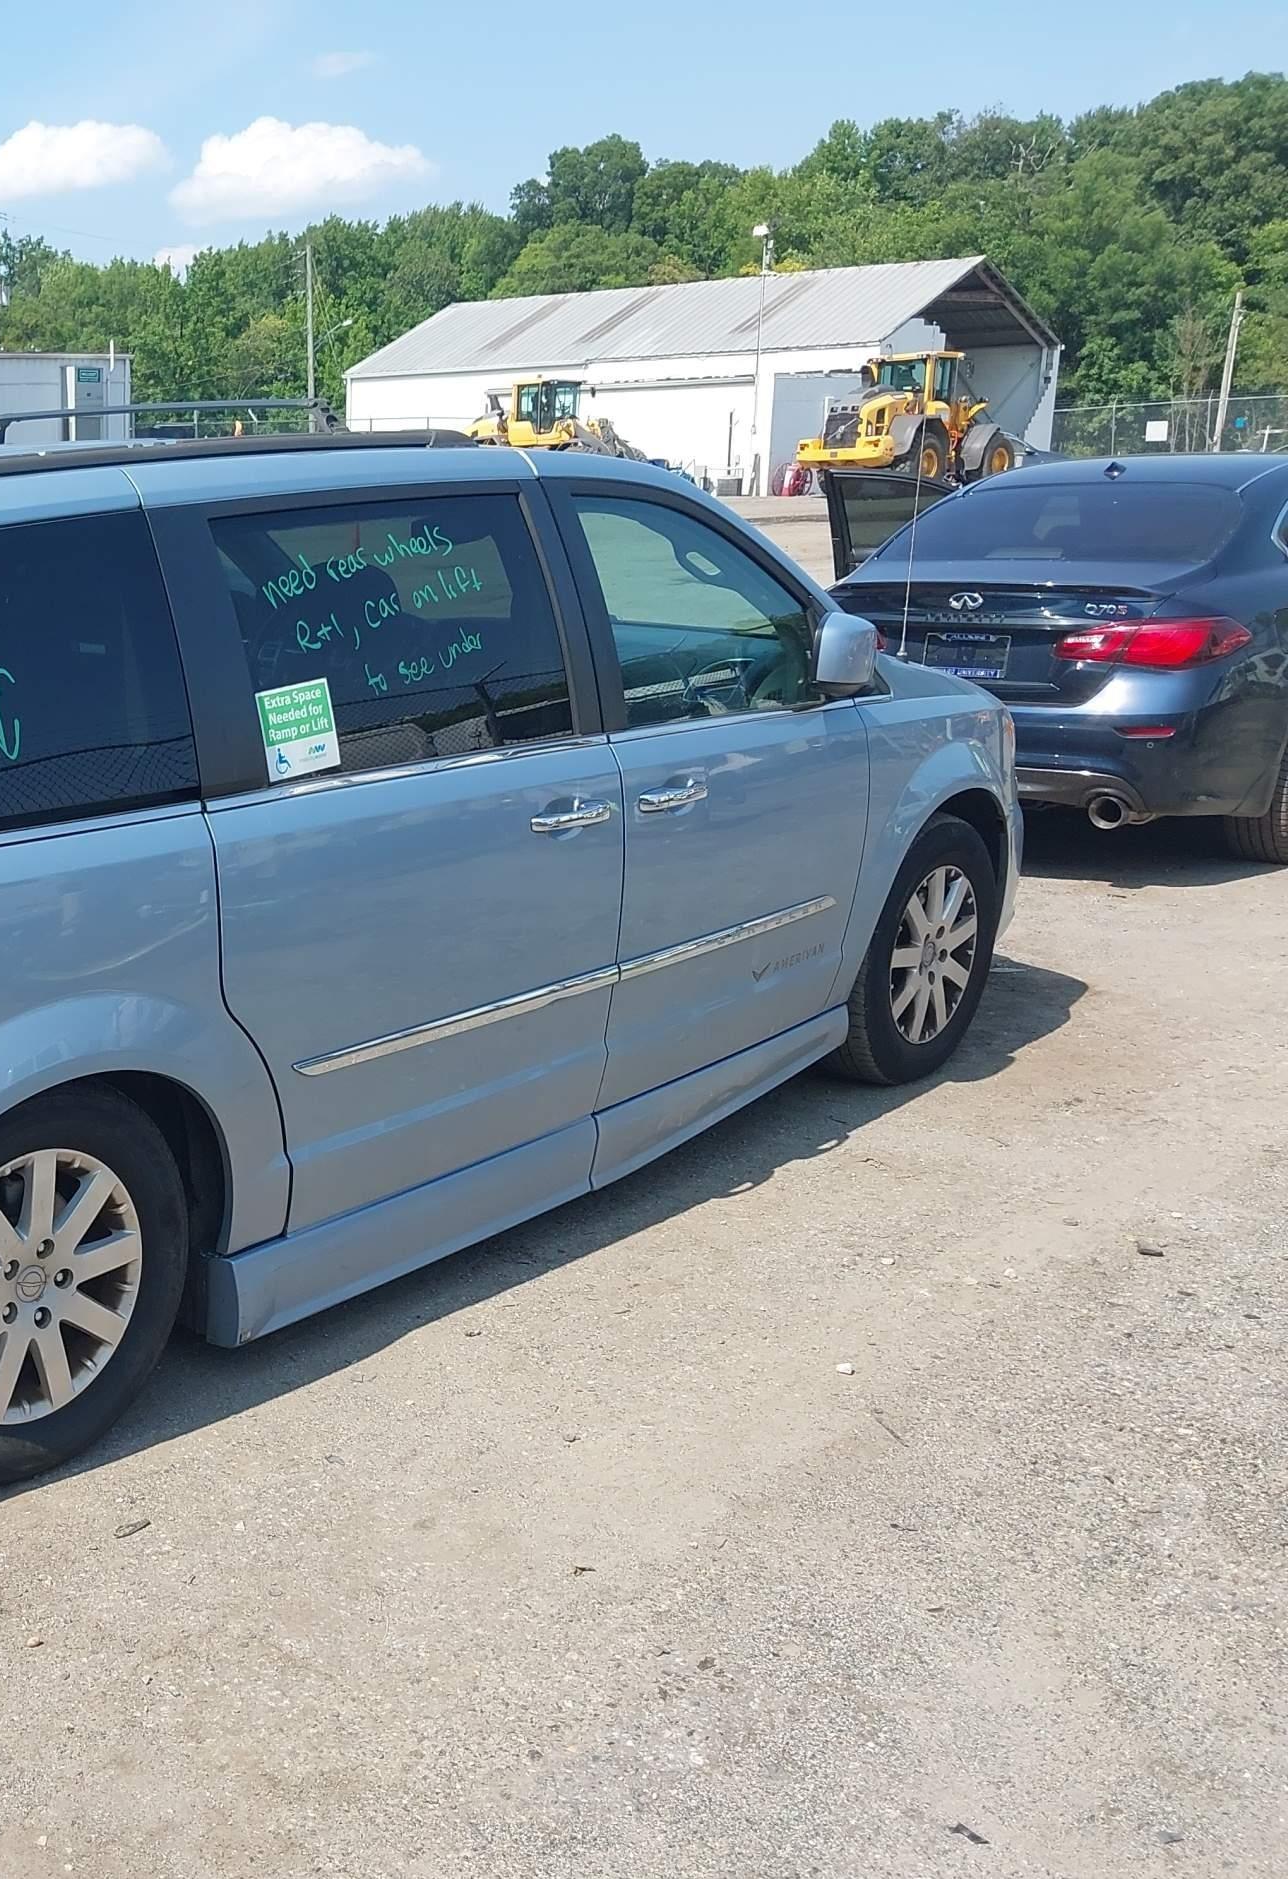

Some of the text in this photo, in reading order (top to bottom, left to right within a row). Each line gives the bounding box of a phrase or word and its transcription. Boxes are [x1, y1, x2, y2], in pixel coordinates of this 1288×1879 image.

[374, 525, 453, 568] wheels
[437, 566, 483, 599] lift
[365, 627, 482, 696] to see under
[263, 688, 322, 710] Extra Space
[268, 703, 323, 726] Needed for
[268, 717, 329, 742] Ramp or Lift
